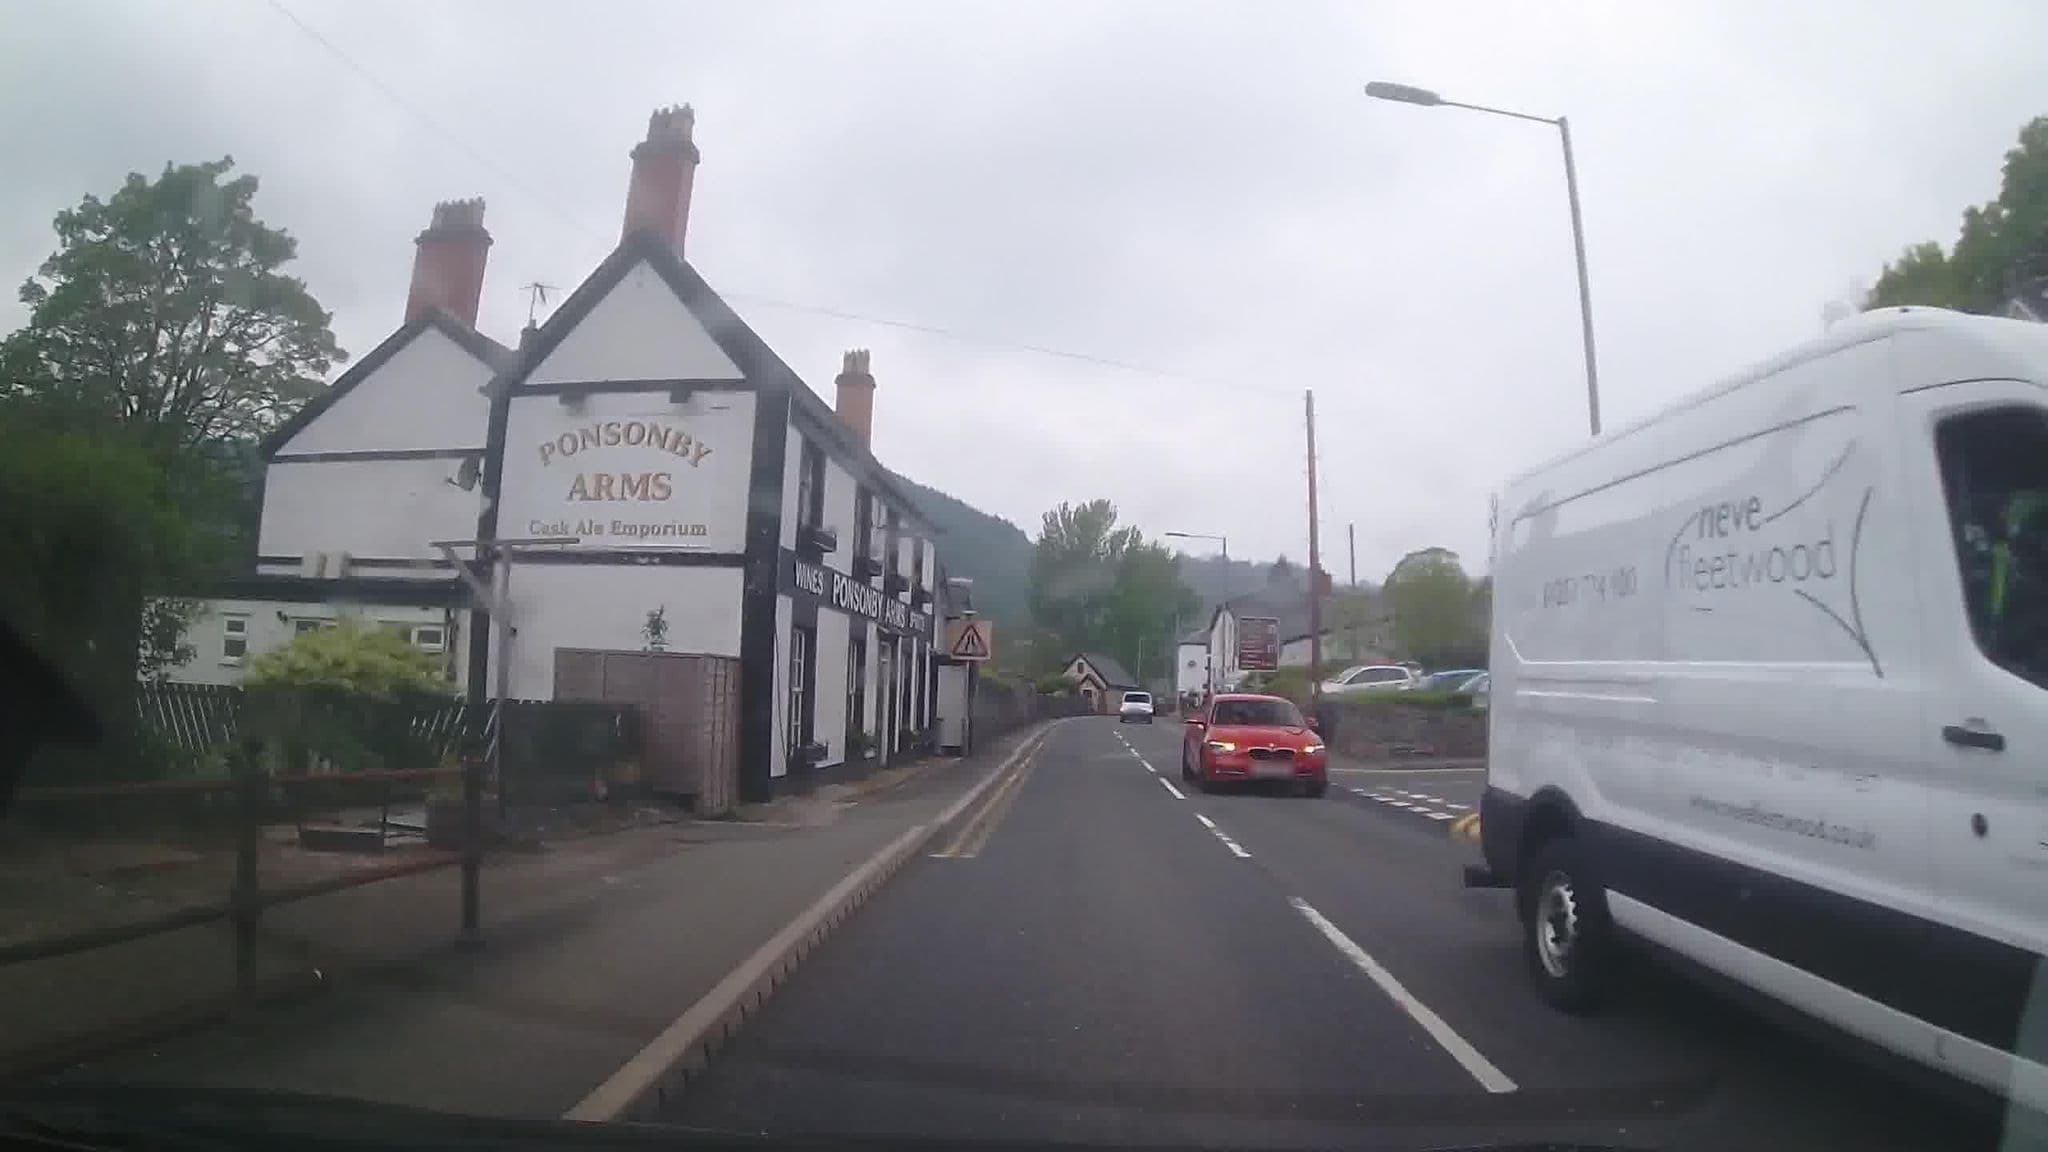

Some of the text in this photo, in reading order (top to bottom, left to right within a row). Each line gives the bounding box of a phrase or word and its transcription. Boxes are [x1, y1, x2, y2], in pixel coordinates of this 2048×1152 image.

[539, 421, 714, 468] PONSONBY
[566, 472, 672, 501] ARMS
[529, 520, 708, 539] Cask Ale Emporium
[1698, 496, 1761, 539] neve
[794, 559, 824, 596] WINES
[832, 573, 884, 619] PONSONBY
